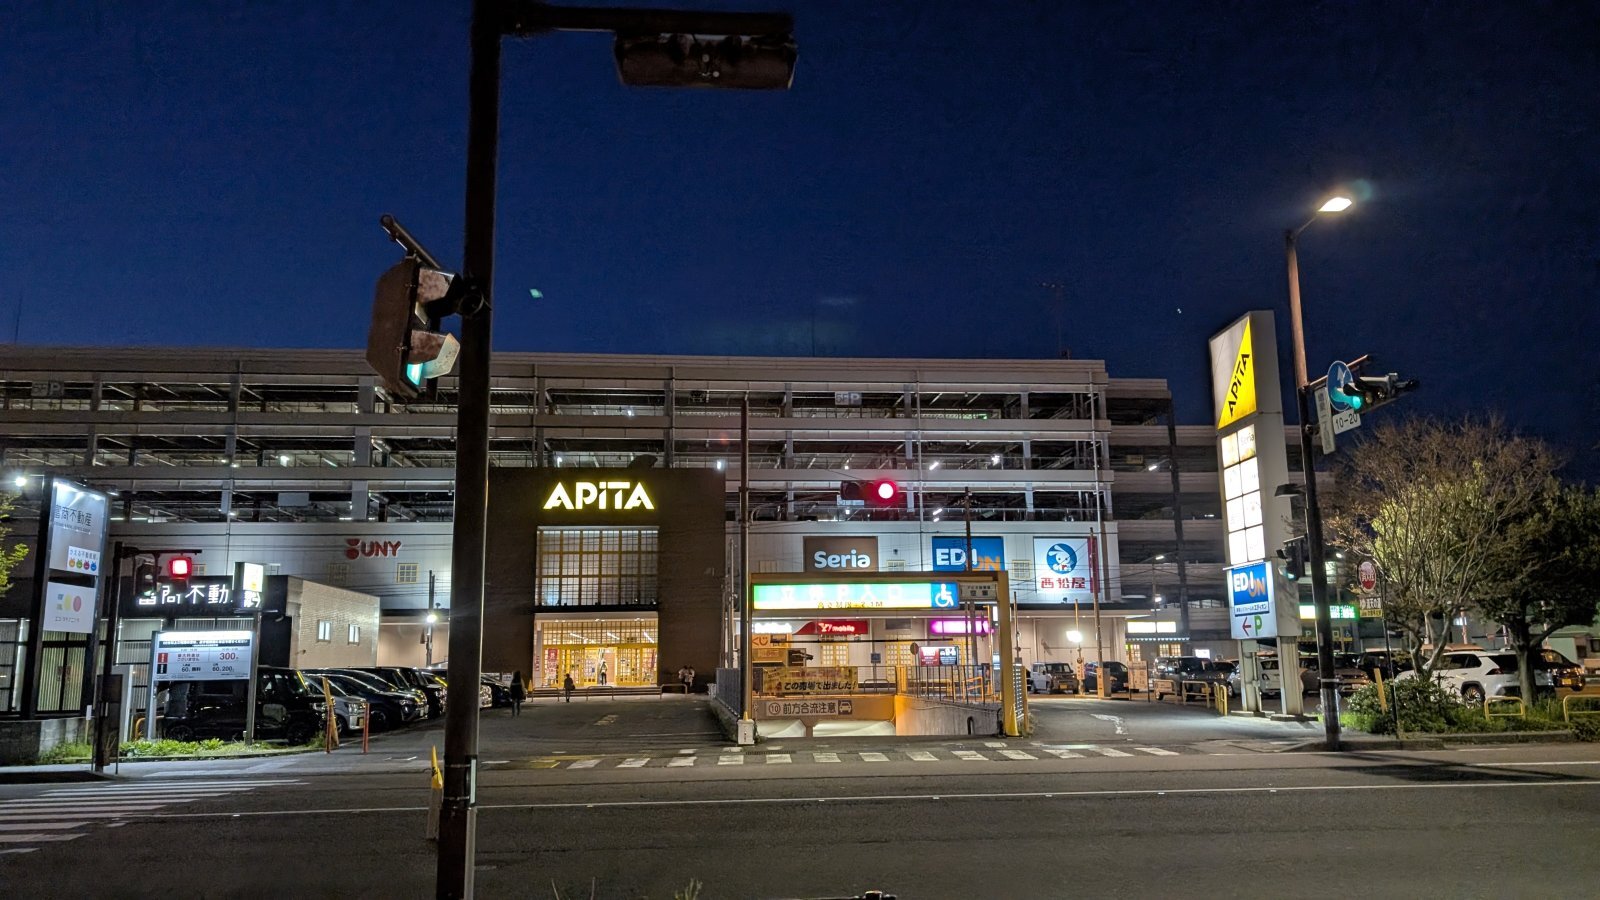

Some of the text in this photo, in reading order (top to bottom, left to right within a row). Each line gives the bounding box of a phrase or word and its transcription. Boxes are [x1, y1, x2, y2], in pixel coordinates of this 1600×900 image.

[850, 393, 860, 404] P
[1335, 412, 1358, 428] 10-20
[360, 540, 402, 559] UNY
[813, 549, 871, 570] Seria
[1040, 577, 1086, 589] 西松屋
[1254, 615, 1263, 636] P
[219, 652, 236, 660] 300
[783, 702, 837, 715] 前方合流注意
